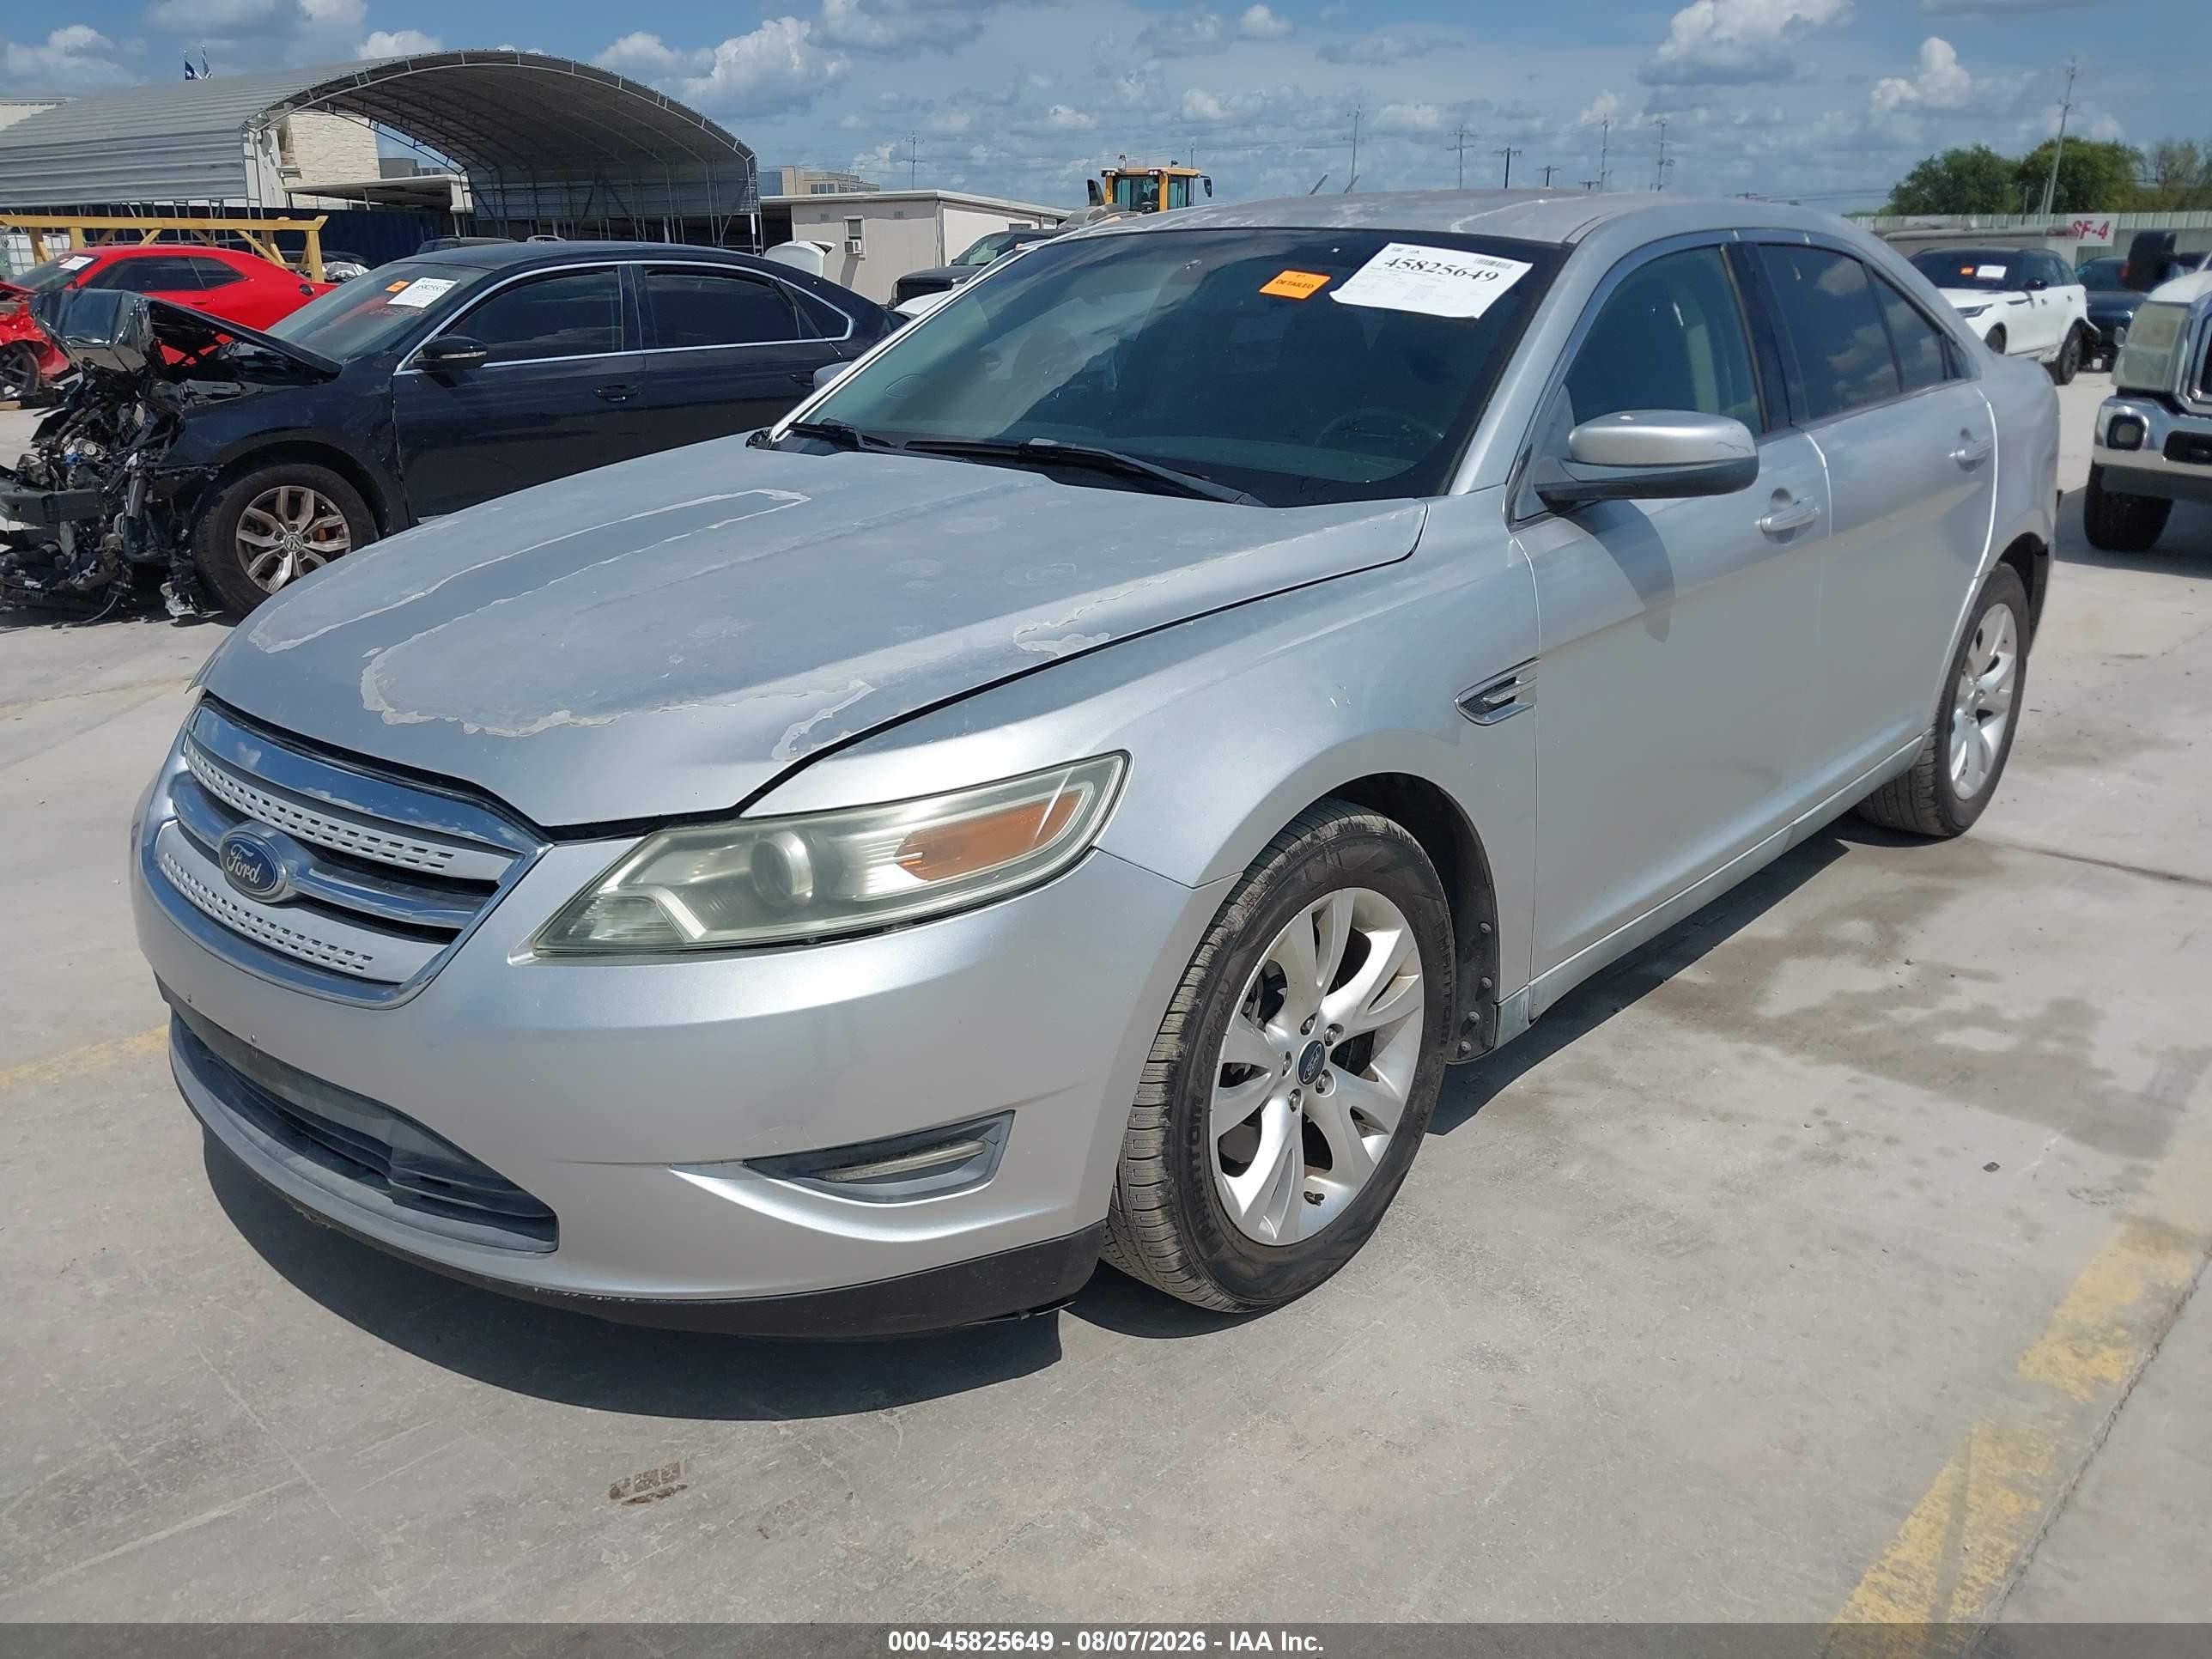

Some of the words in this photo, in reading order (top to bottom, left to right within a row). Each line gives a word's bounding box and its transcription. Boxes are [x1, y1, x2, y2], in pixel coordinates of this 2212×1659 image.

[2072, 220, 2110, 240] SF-4
[1384, 256, 1500, 282] 45825649
[1275, 279, 1315, 289] DETAILED
[226, 842, 262, 884] Ford
